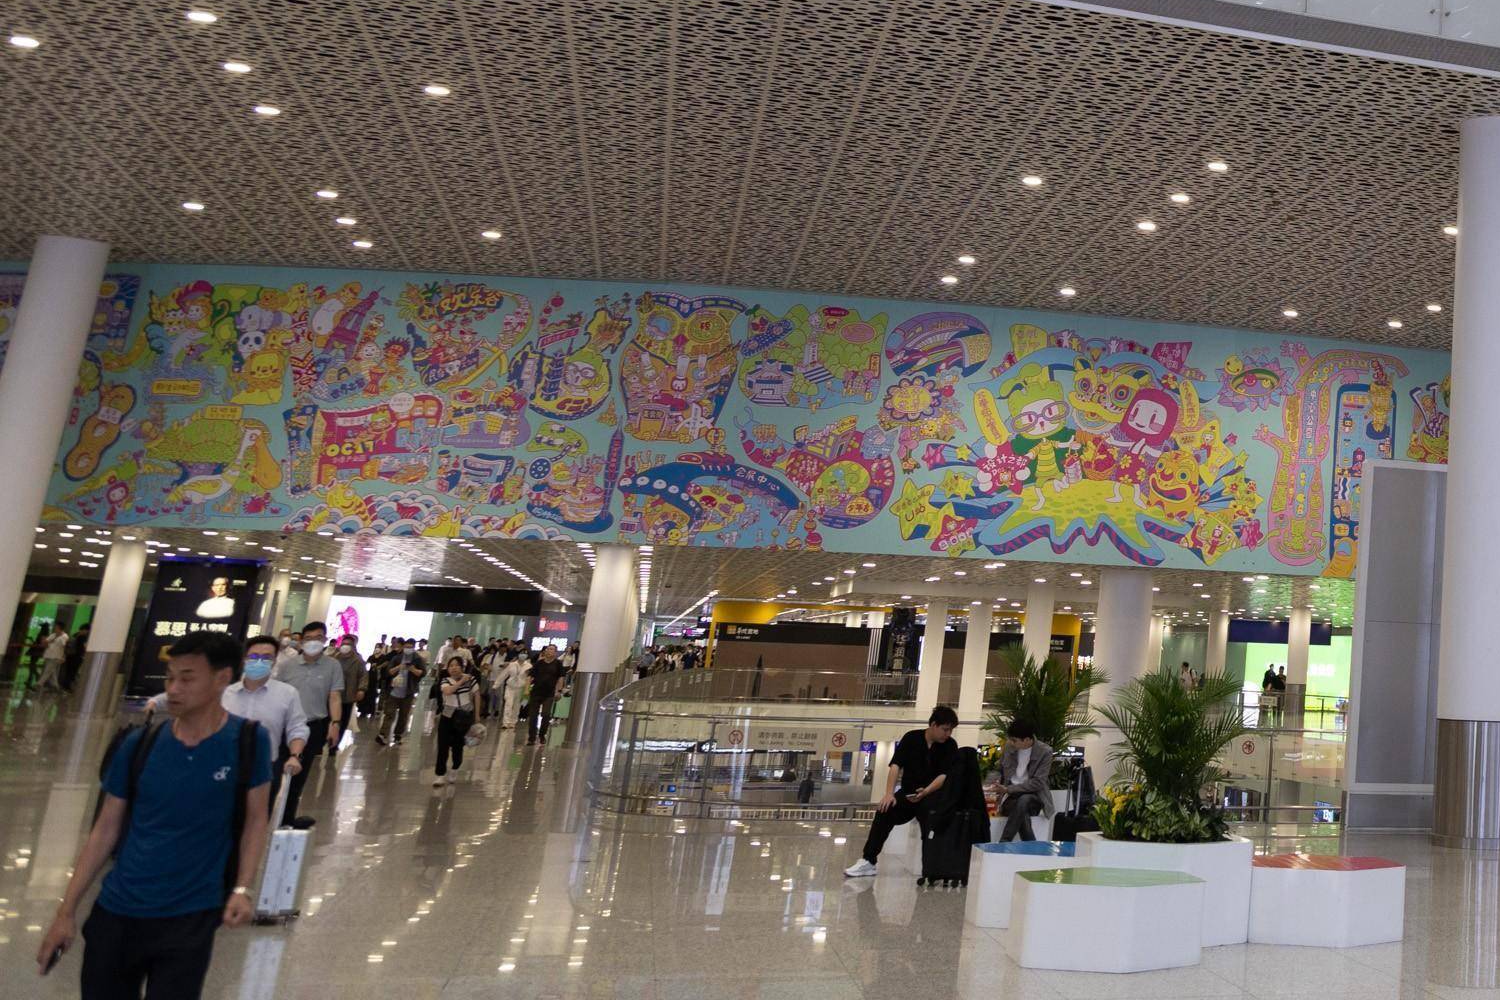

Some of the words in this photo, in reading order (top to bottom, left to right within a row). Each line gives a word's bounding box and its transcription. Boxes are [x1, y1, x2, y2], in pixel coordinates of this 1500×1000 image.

[983, 453, 1028, 472] 设计之都
[735, 466, 780, 491] 会展中心
